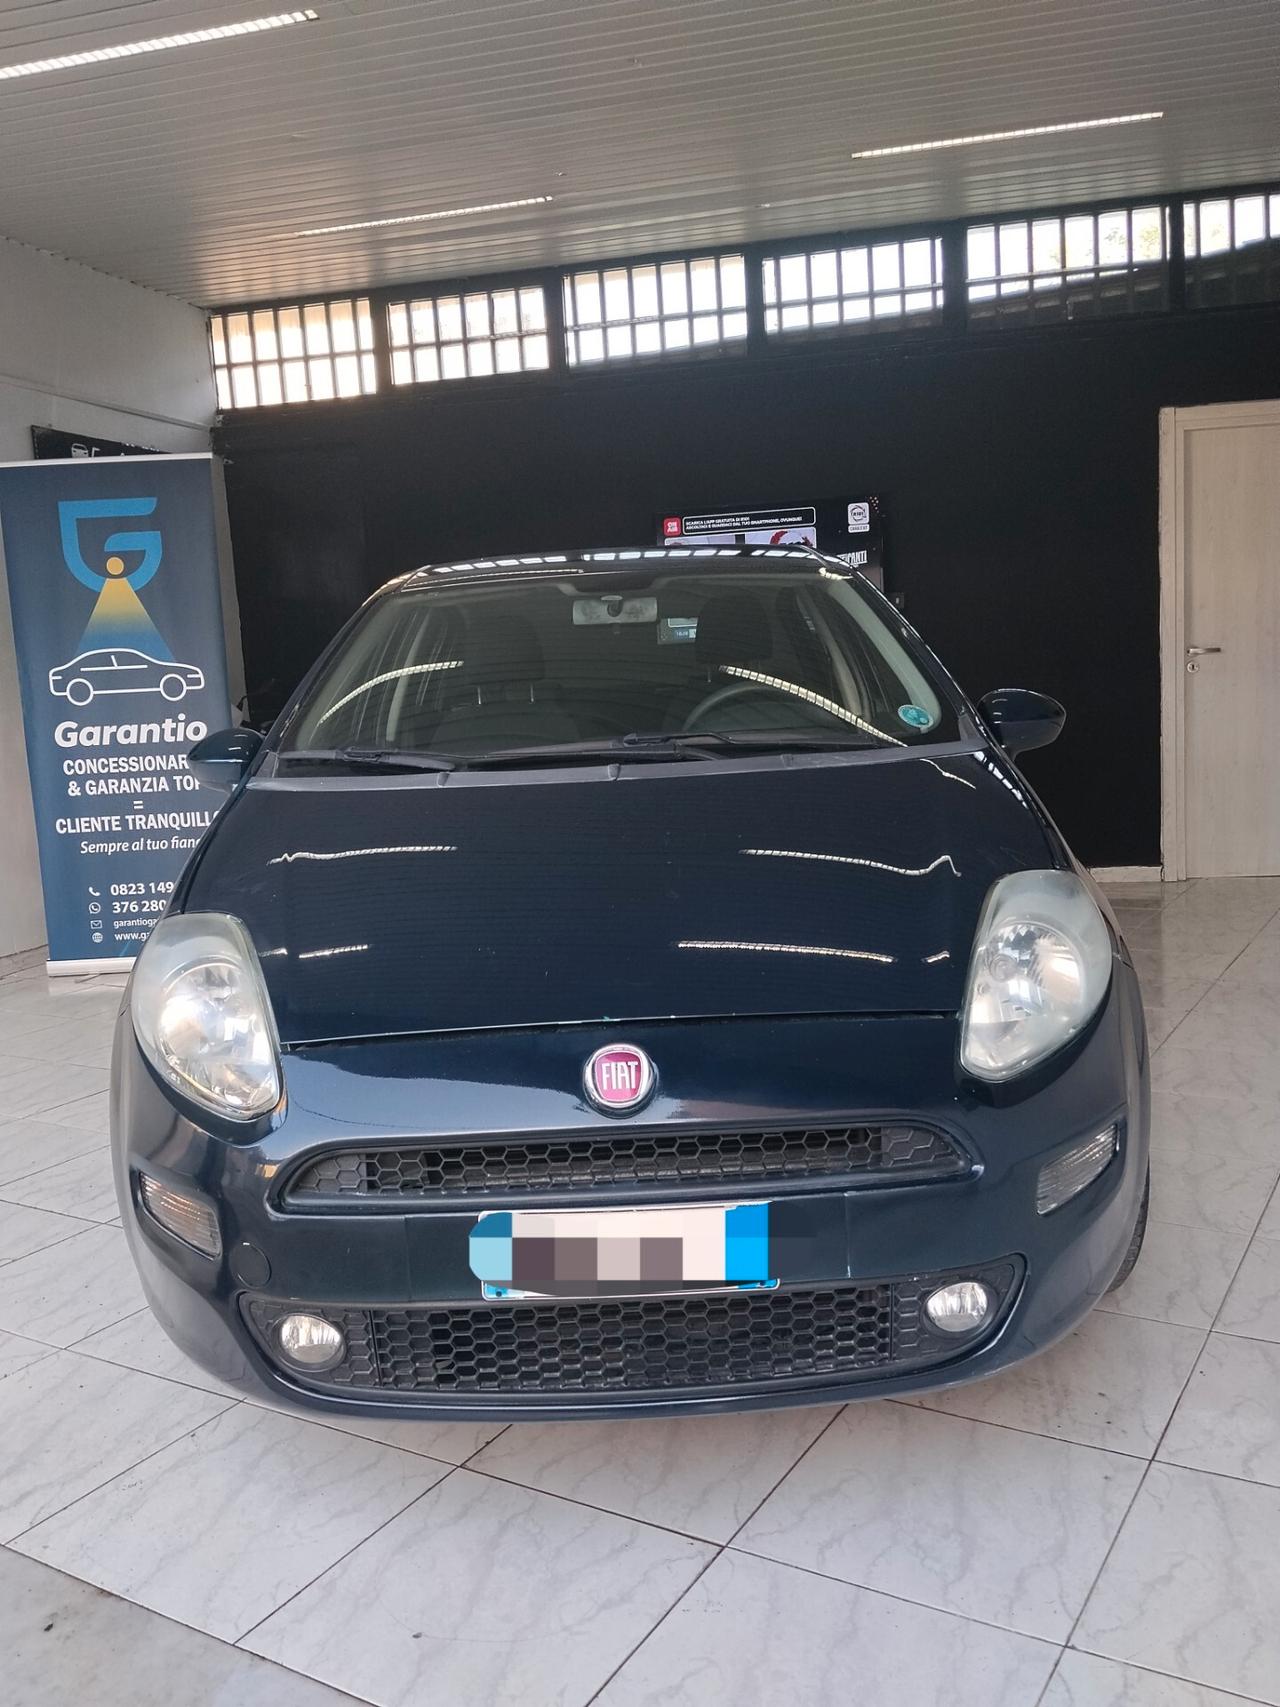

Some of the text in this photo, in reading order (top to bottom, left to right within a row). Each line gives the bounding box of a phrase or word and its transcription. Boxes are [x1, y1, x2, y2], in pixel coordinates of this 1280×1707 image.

[54, 713, 208, 748] Garantio
[67, 780, 82, 796] &
[85, 776, 169, 795] GARANZIA
[56, 810, 220, 834] CLIENTE TRANQUILL
[80, 841, 129, 855] Sempre
[131, 838, 144, 851] al
[146, 839, 168, 850] tuo
[110, 881, 175, 896] 0823 149
[112, 901, 139, 914] 376
[601, 1061, 639, 1090] FIAT
